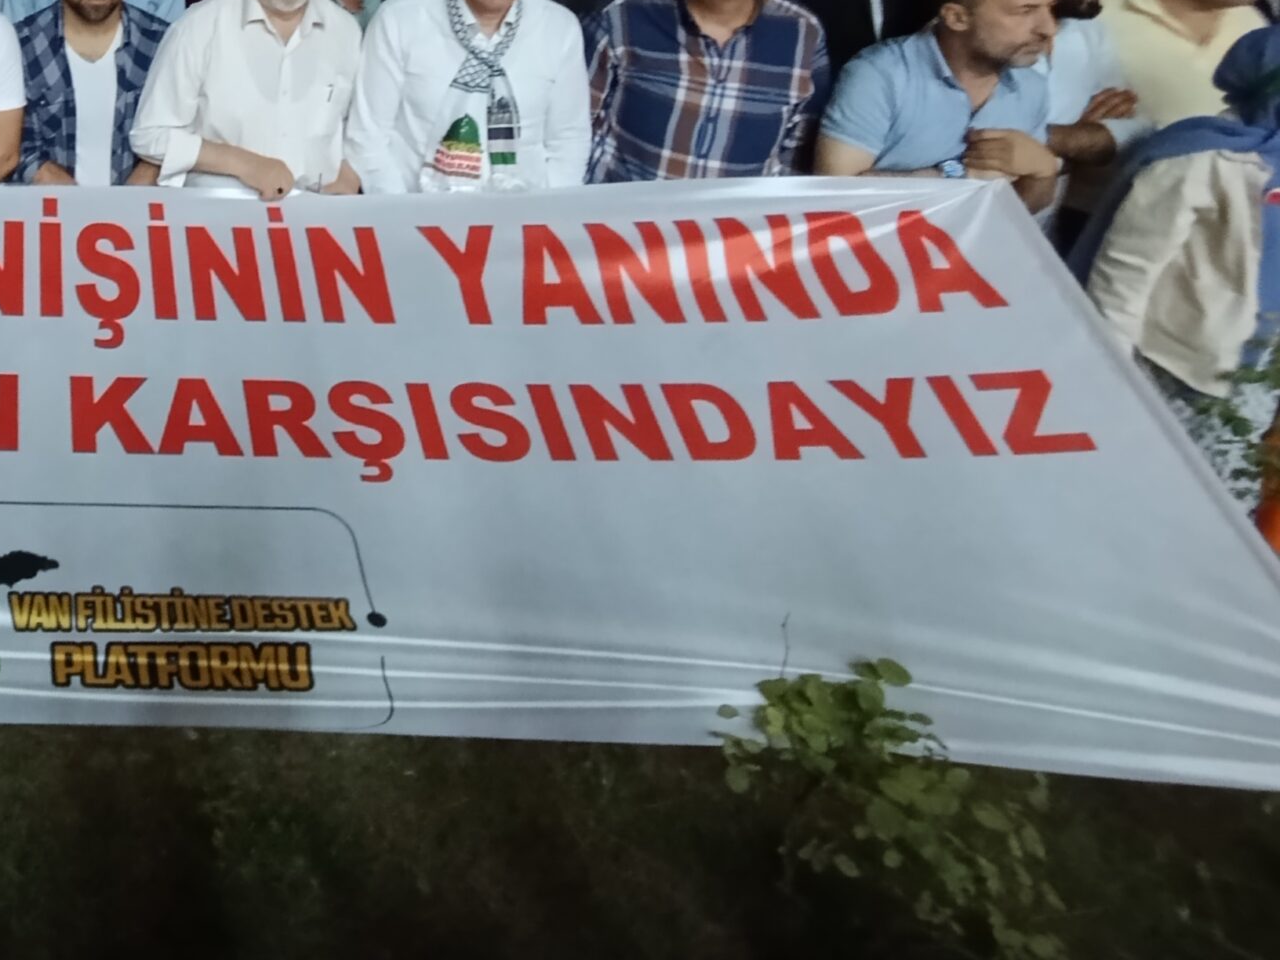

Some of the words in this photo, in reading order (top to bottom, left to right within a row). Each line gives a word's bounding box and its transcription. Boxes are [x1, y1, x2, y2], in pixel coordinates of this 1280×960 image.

[416, 210, 1010, 325] YANINDA
[69, 369, 1098, 483] KARŞISINDAYIZ
[8, 592, 71, 632] VAN
[74, 585, 231, 632] FİLİSTİNE
[230, 596, 357, 632] DESTEK
[51, 641, 315, 690] PLATFORMU
